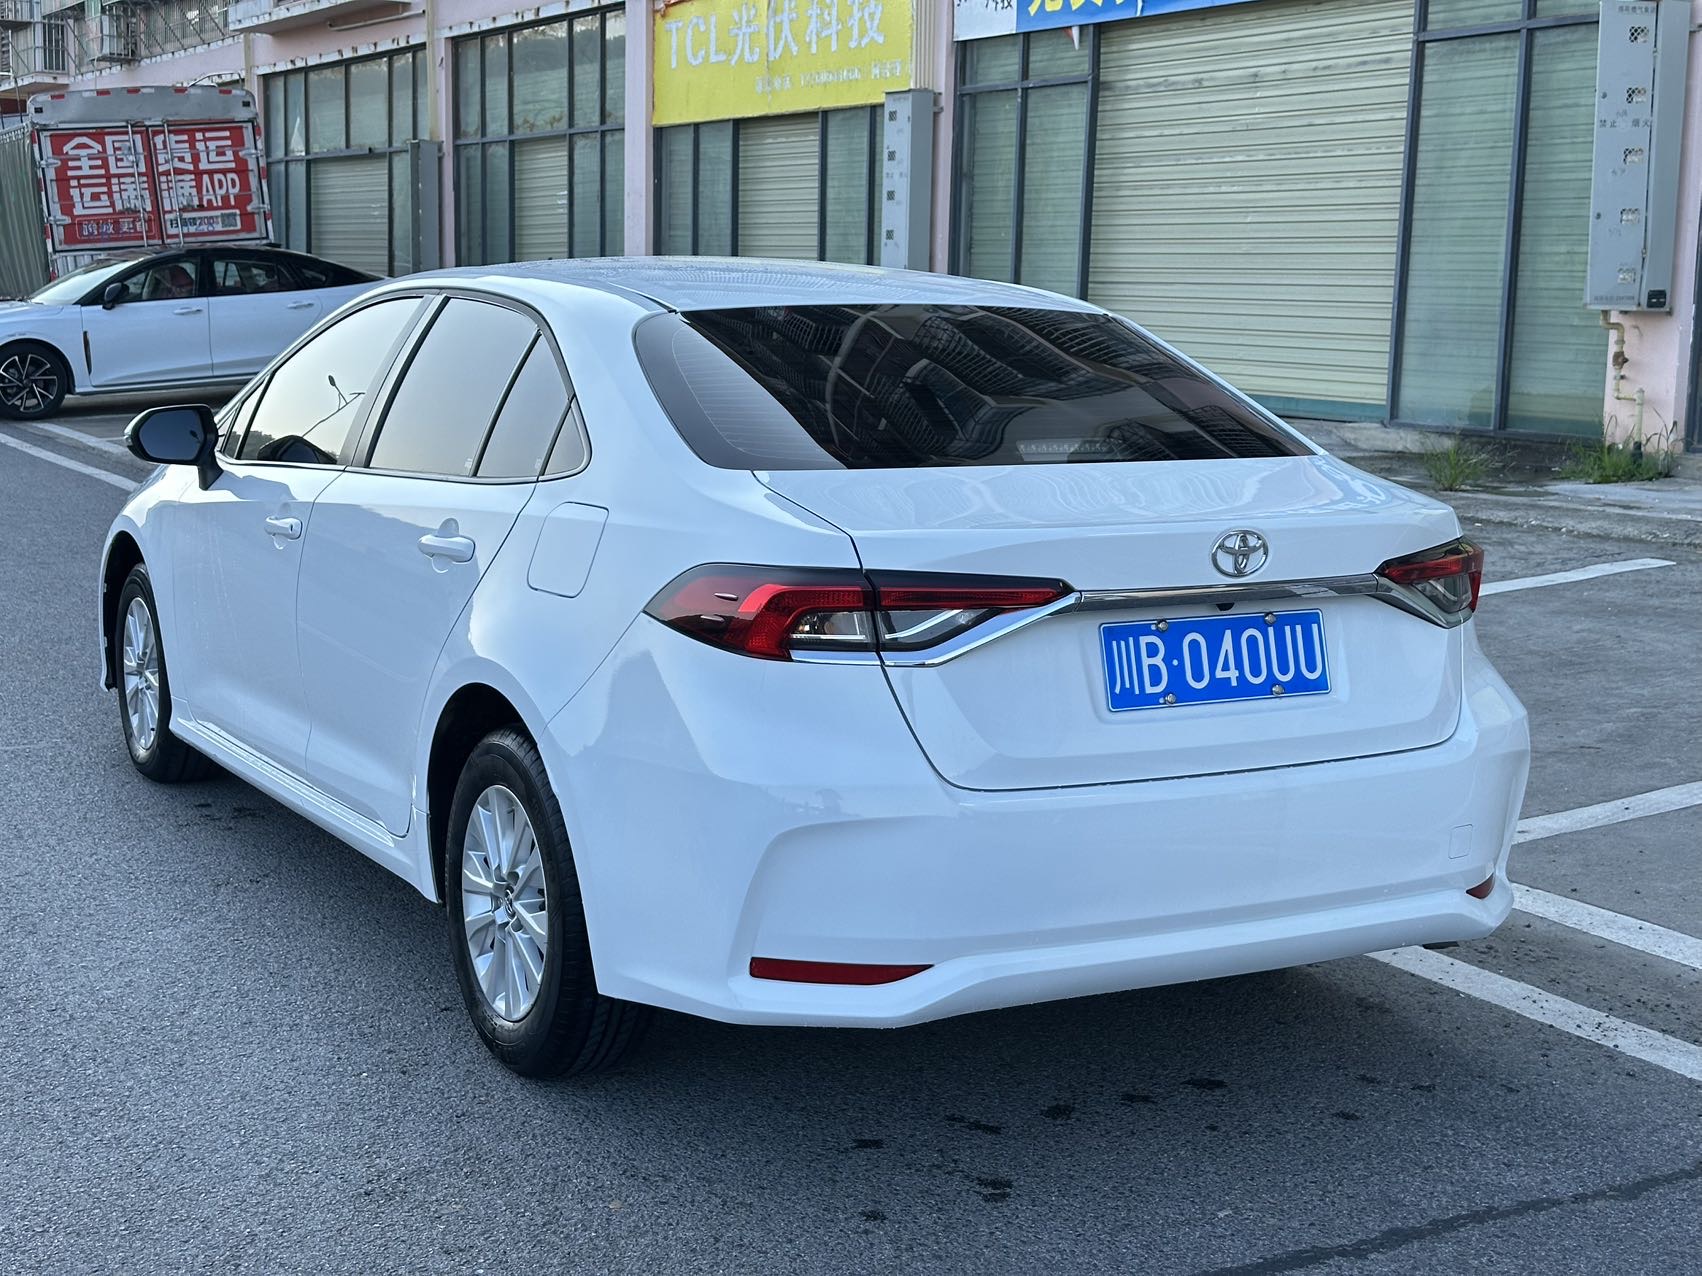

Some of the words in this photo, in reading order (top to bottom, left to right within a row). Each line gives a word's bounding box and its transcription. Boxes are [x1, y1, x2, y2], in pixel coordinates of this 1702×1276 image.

[665, 0, 885, 69] TCL光伏科技
[63, 130, 236, 176] 全国货运
[69, 172, 240, 216] 运满满APP
[1111, 623, 1323, 695] 川B·040UU
